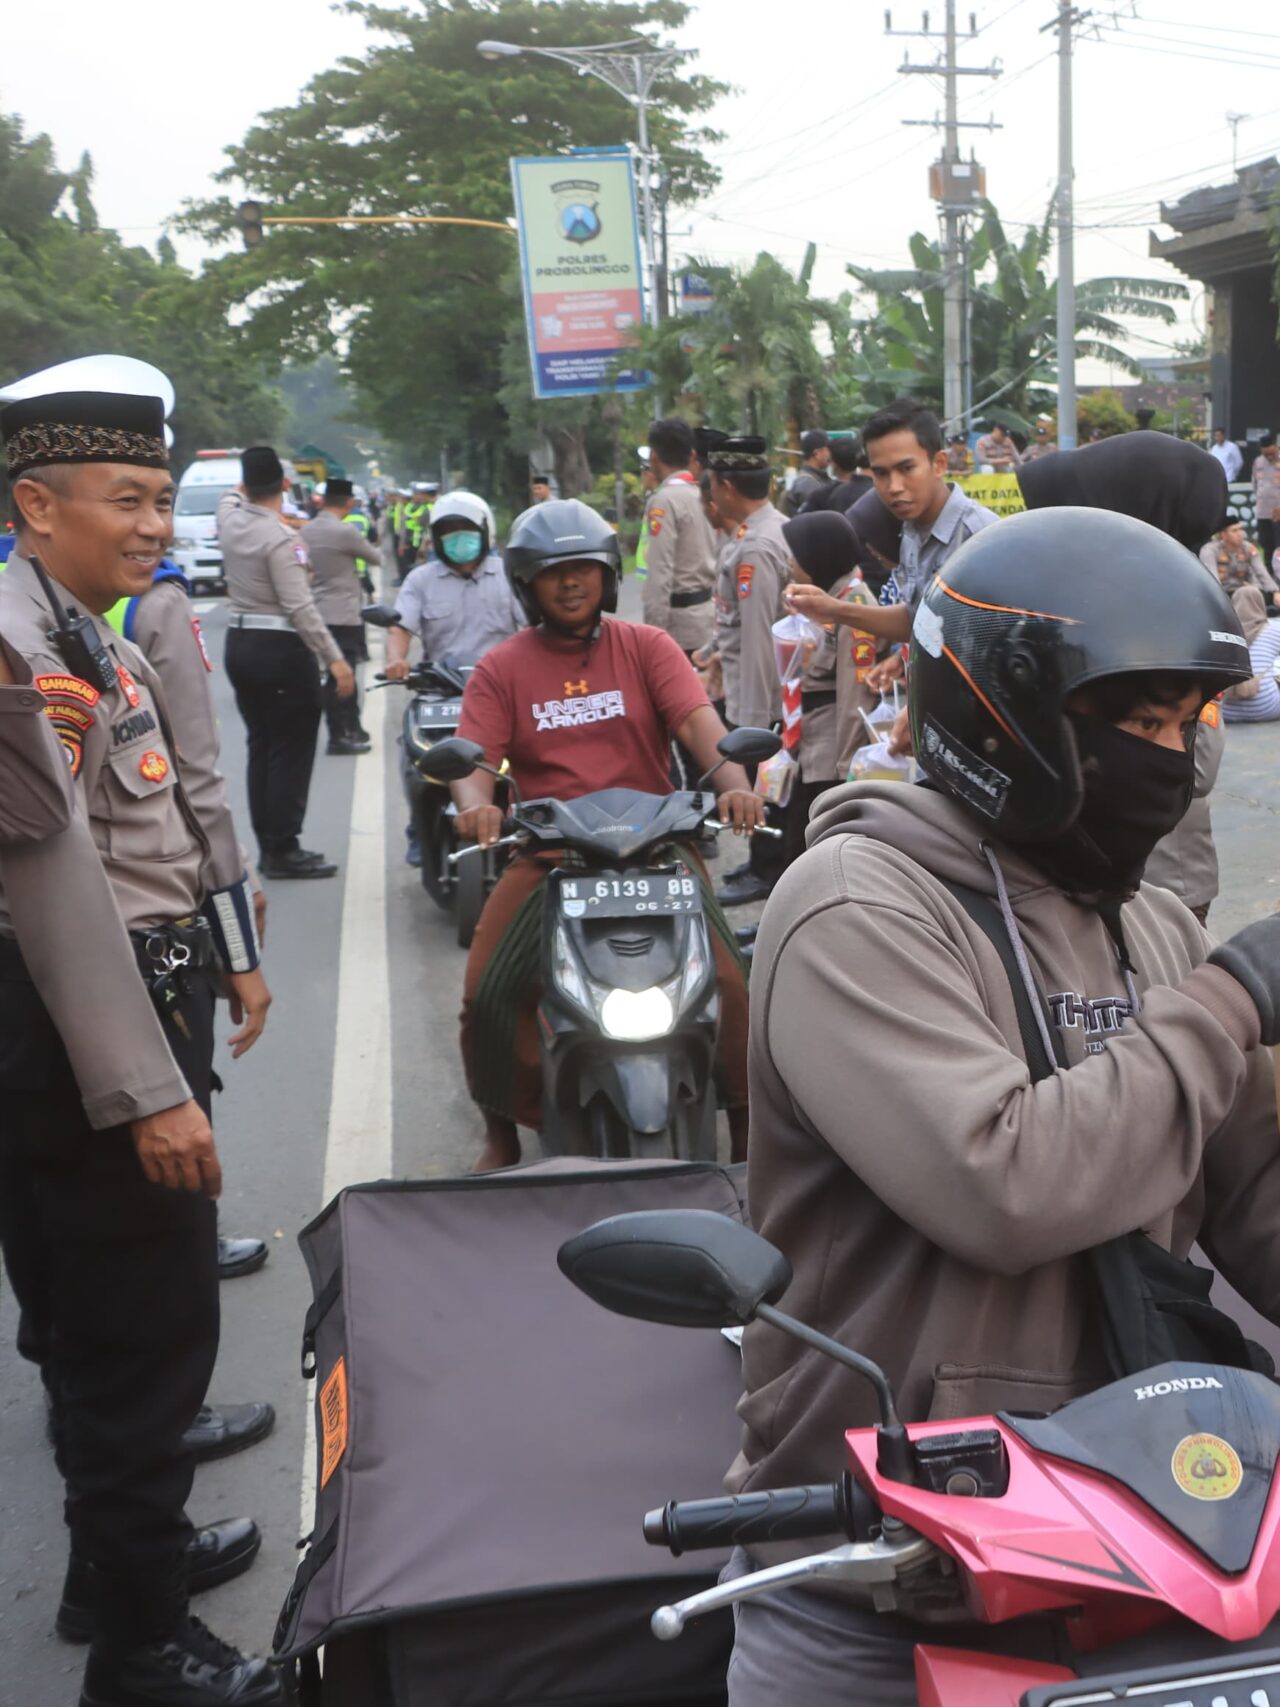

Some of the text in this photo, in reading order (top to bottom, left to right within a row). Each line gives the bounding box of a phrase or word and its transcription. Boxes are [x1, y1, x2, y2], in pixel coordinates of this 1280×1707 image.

[557, 254, 607, 265] POLRES
[532, 690, 624, 720] UNDER
[536, 704, 626, 731] ARMOUR
[562, 882, 578, 898] N
[596, 879, 650, 898] 6139
[1134, 1376, 1223, 1400] HONDA
